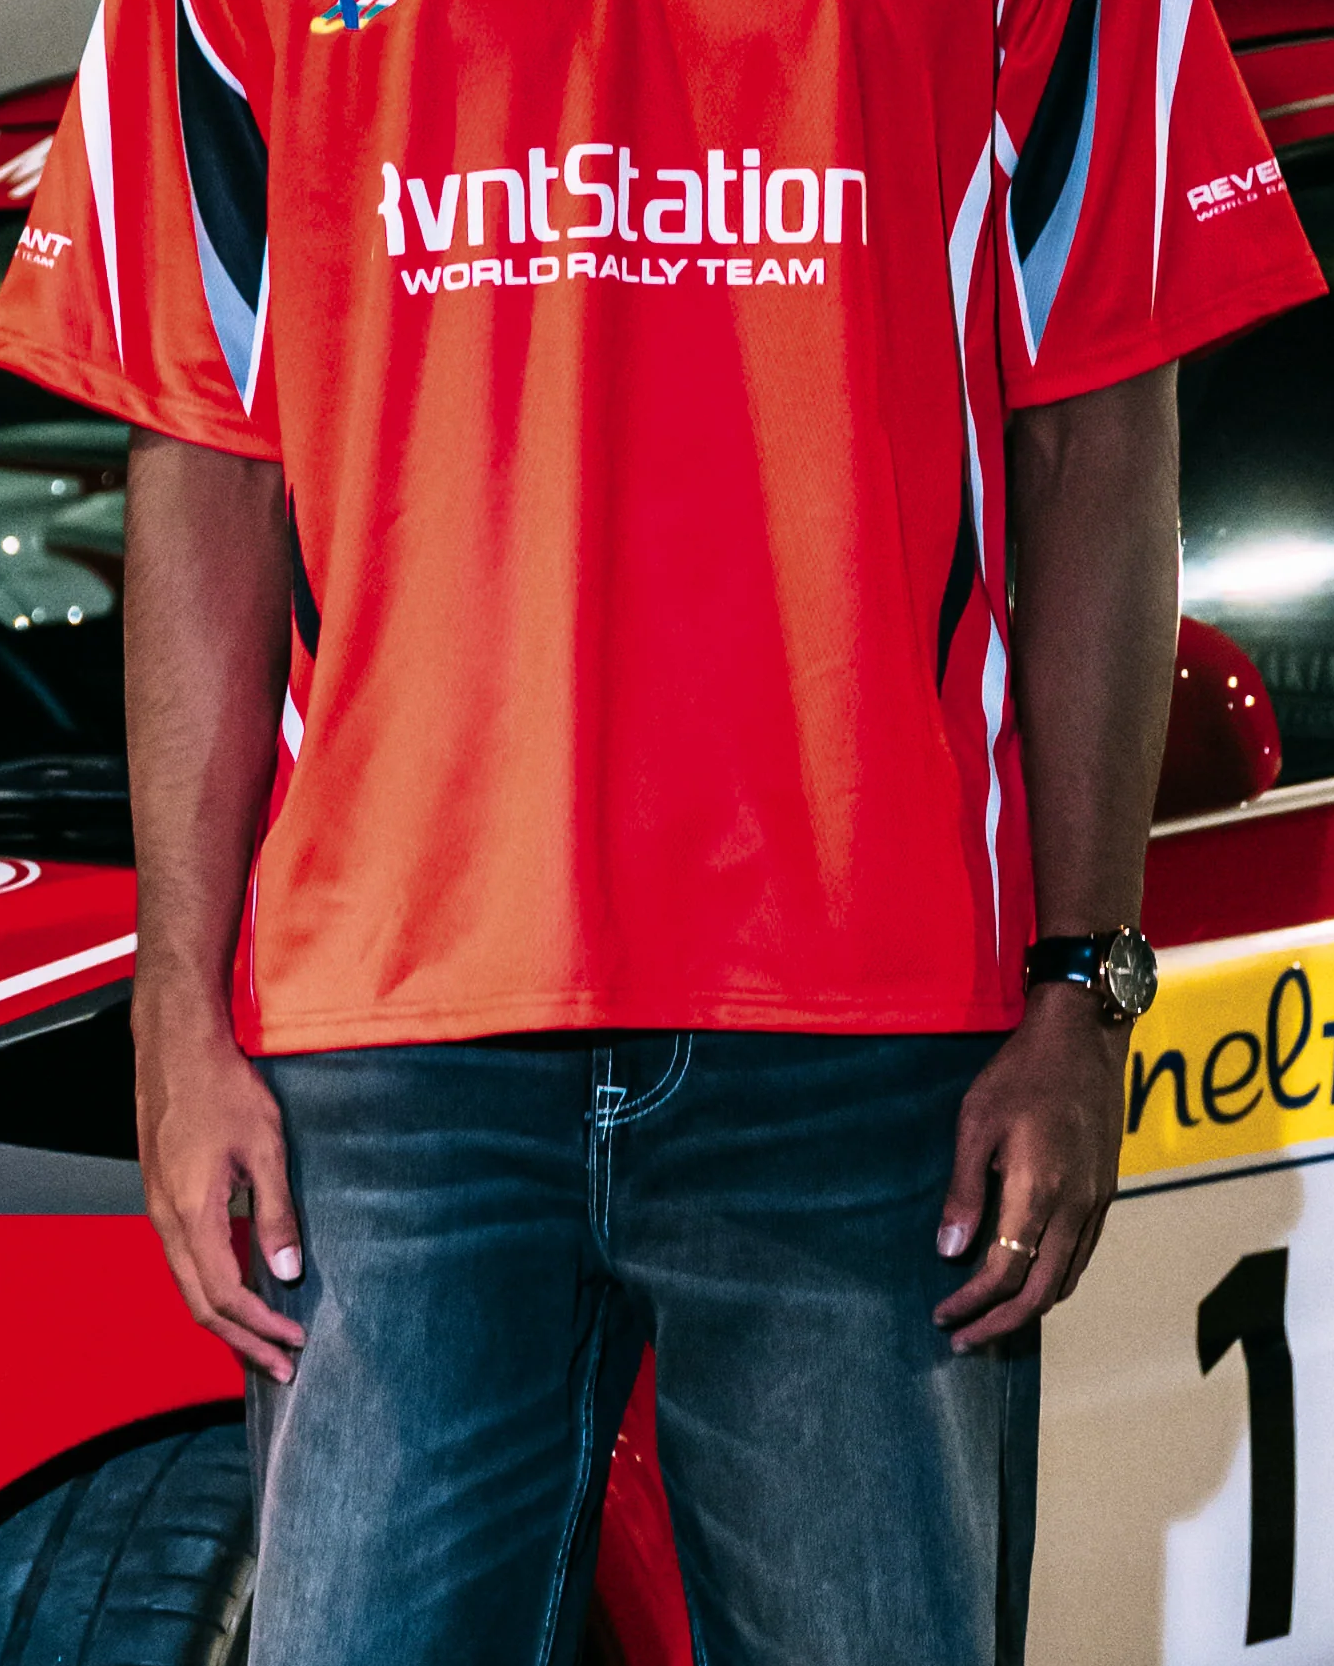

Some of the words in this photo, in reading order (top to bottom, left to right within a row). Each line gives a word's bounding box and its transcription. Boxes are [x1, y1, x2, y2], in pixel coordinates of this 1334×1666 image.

[400, 256, 560, 296] WORLD
[567, 252, 689, 285] RALLY
[697, 258, 825, 286] TEAM
[1195, 1247, 1297, 1648] 1
